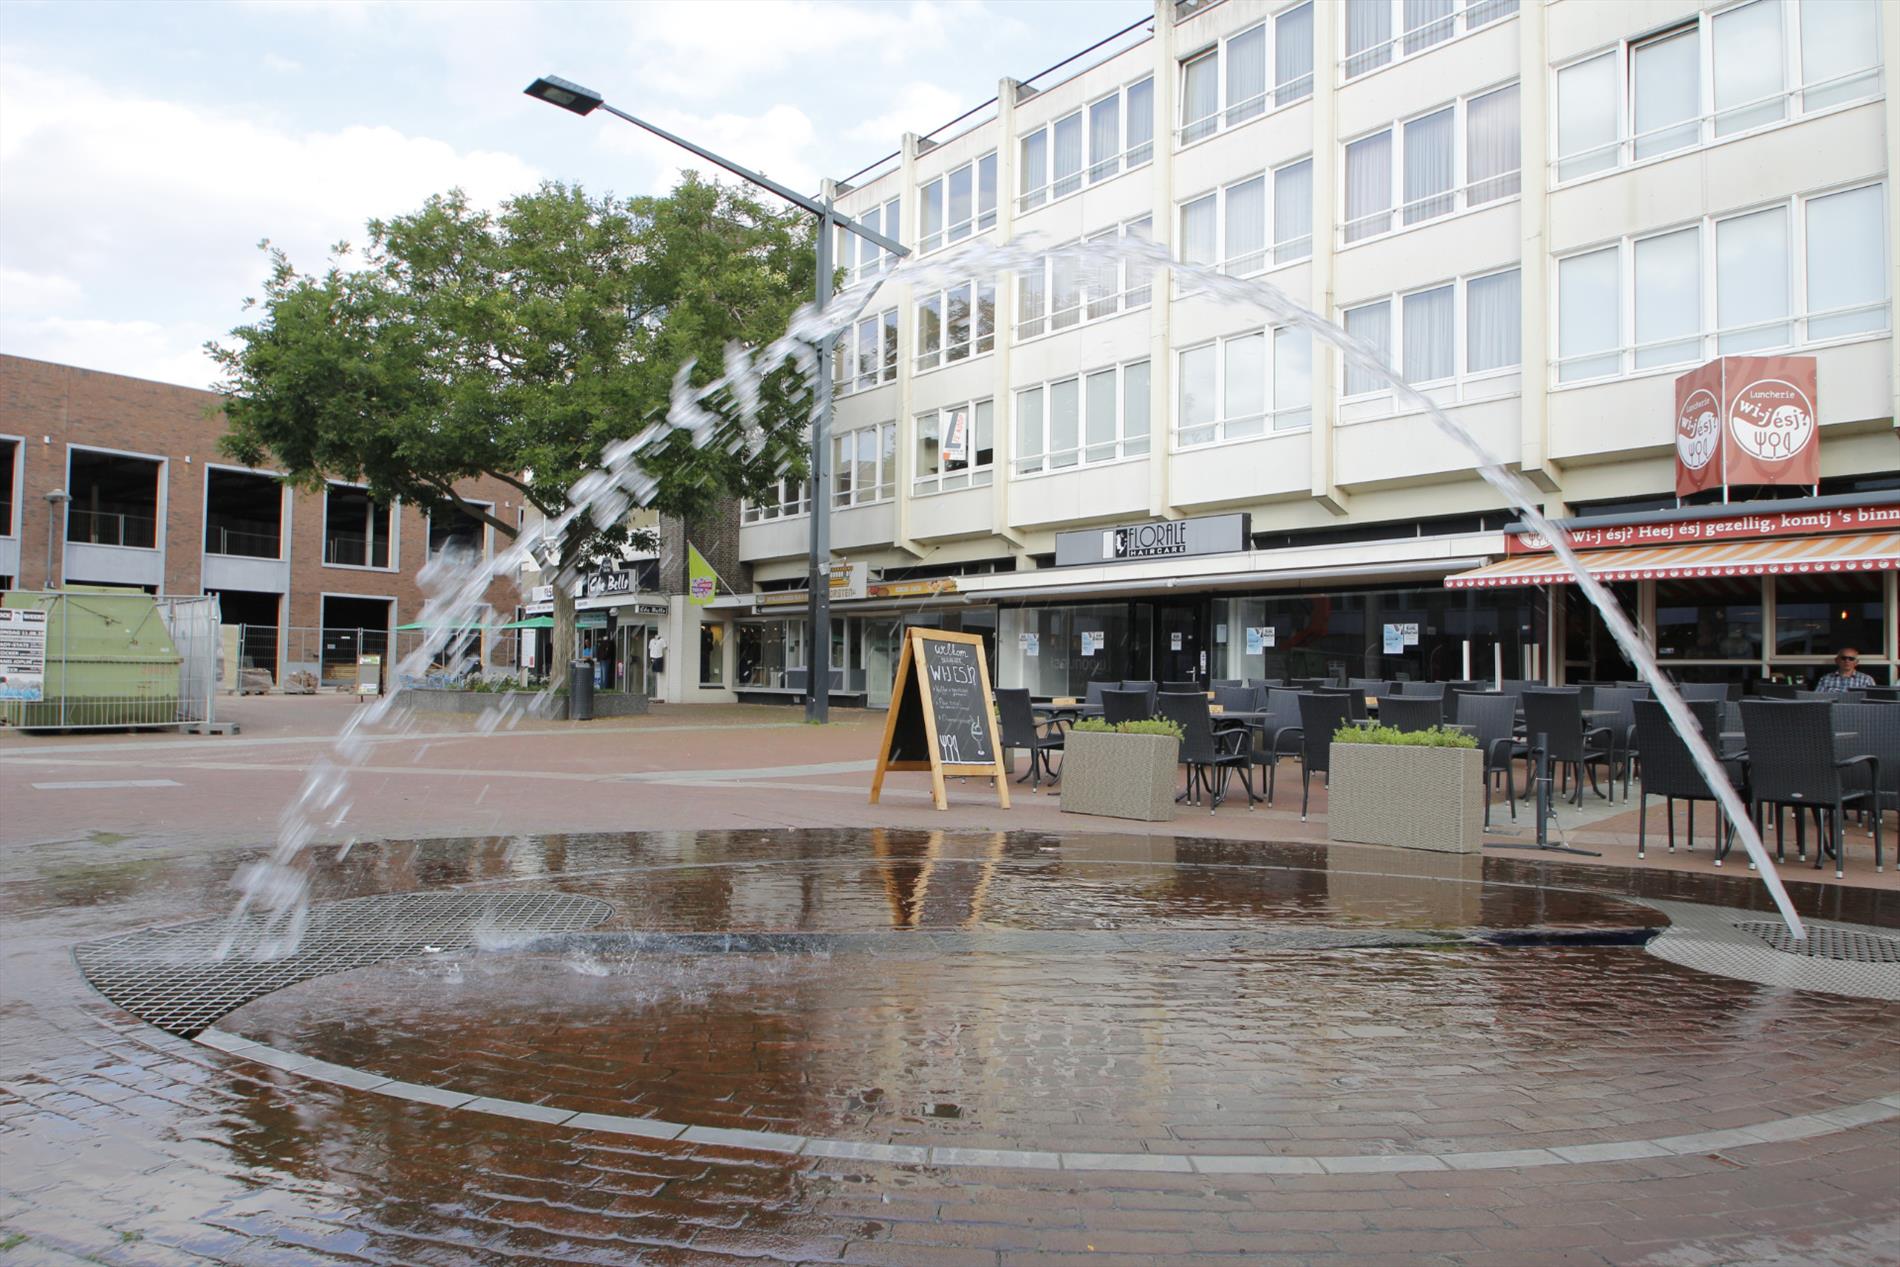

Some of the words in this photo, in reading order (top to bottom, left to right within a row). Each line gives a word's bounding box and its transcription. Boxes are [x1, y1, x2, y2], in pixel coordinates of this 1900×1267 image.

[1750, 390, 1795, 399] Luncherie
[1740, 400, 1773, 425] wi-j
[1128, 521, 1187, 549] FLORALE
[1572, 530, 1602, 545] Wi-j
[1606, 527, 1633, 543] ésj?
[1638, 525, 1674, 540] Heej
[1679, 521, 1700, 537] ésj
[1705, 517, 1776, 537] gezellig,
[1781, 511, 1832, 529] komtj
[1129, 545, 1186, 557] HAIRCARE
